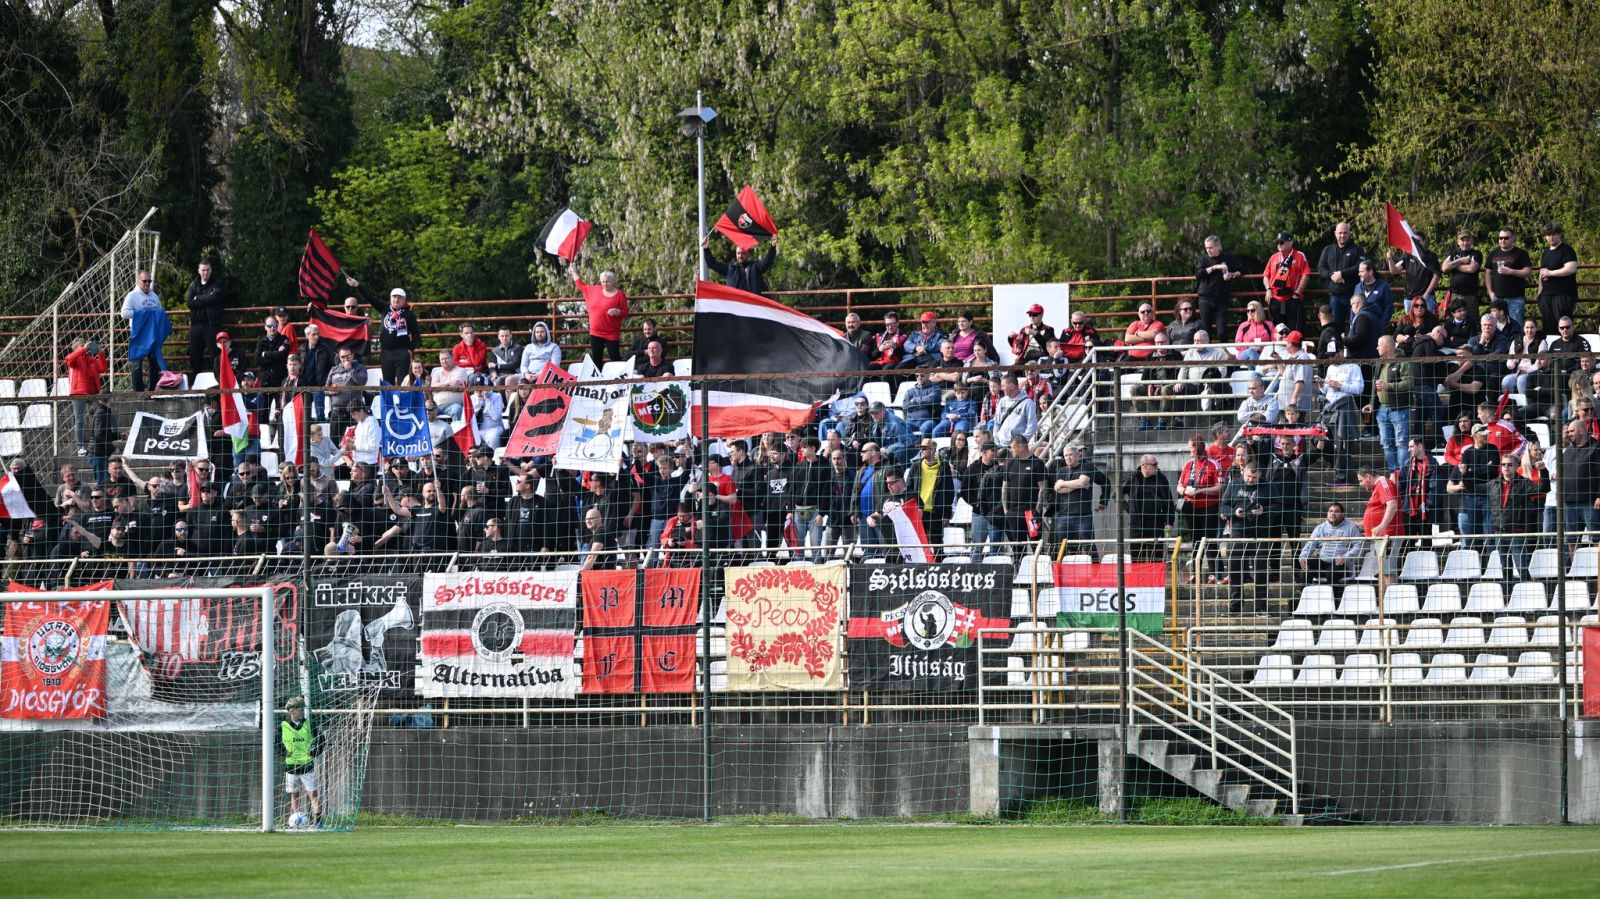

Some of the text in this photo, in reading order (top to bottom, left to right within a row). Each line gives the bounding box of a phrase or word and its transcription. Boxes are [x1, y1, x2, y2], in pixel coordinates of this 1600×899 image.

[637, 403, 661, 416] MFC
[143, 437, 191, 453] pécs
[387, 436, 429, 455] Komló
[433, 575, 567, 606] Szélsőséges
[868, 566, 997, 594] Szélsőséges
[599, 587, 686, 612] P M
[1079, 588, 1137, 612] PÉCS
[751, 597, 809, 628] Pécs
[658, 650, 679, 673] C
[889, 653, 967, 682] Ifjúság
[42, 678, 62, 686] 1910
[431, 663, 565, 688] Alternatíva
